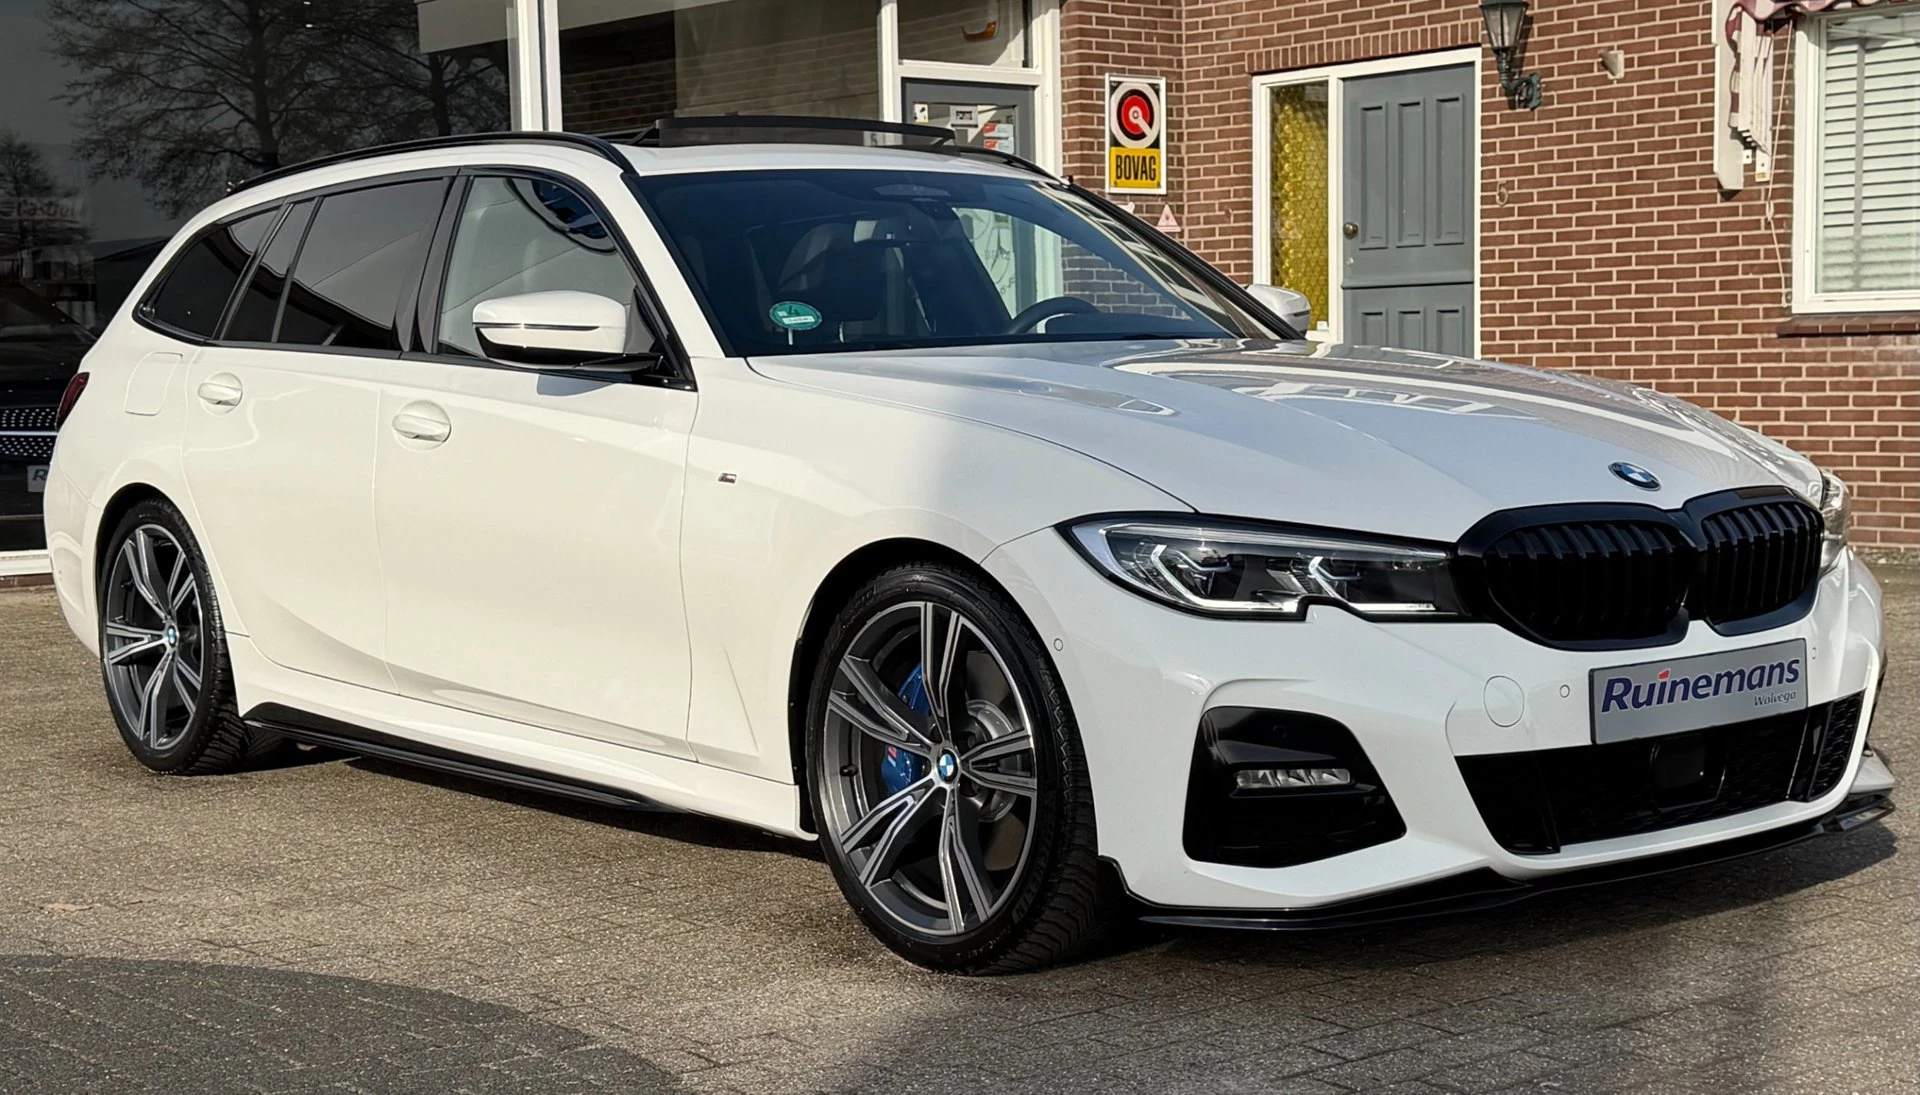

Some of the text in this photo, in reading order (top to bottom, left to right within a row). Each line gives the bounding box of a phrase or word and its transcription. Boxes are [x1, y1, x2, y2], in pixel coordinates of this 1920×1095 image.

[1115, 154, 1157, 182] BOVAG
[1601, 659, 1800, 713] Ruinemans
[1754, 691, 1797, 706] Wolvega
